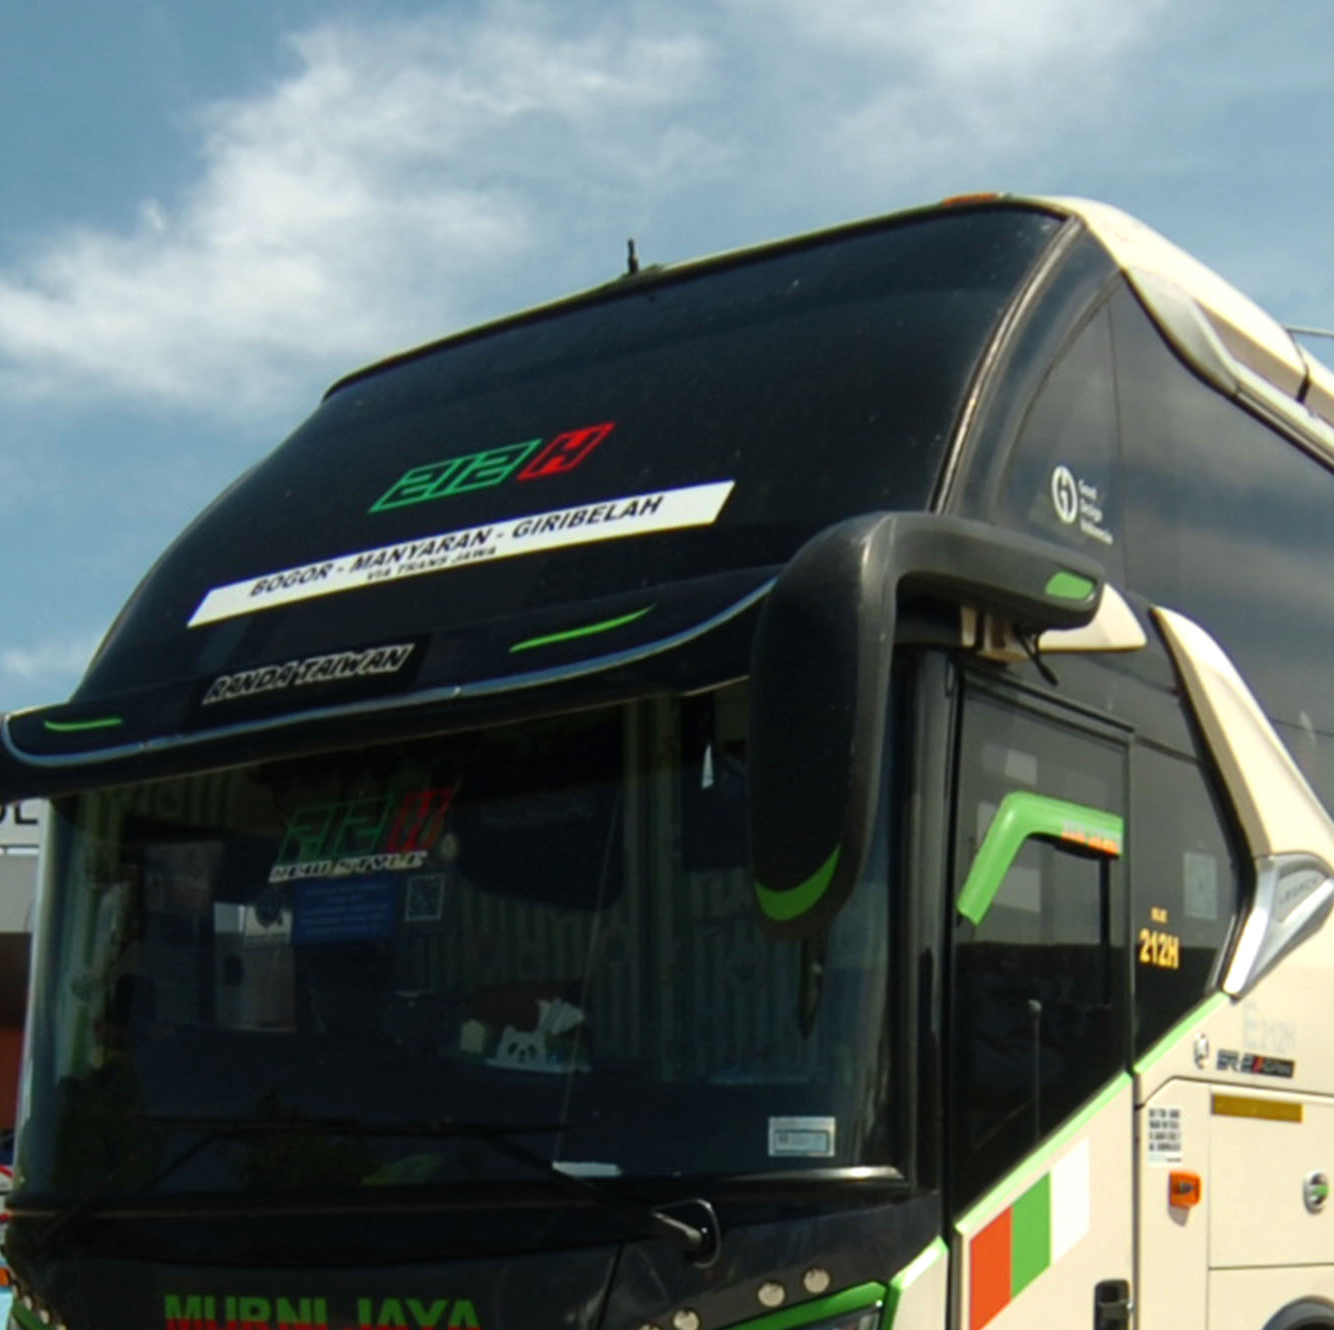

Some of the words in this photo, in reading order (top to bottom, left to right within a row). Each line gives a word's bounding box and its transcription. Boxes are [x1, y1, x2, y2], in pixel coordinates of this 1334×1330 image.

[250, 562, 333, 597] BOGOR
[349, 528, 492, 574] MANYARAN
[512, 495, 664, 539] GIRIBELAH
[396, 555, 448, 575] TRANS
[294, 643, 416, 685] TAIWAN
[1139, 928, 1180, 969] 212H
